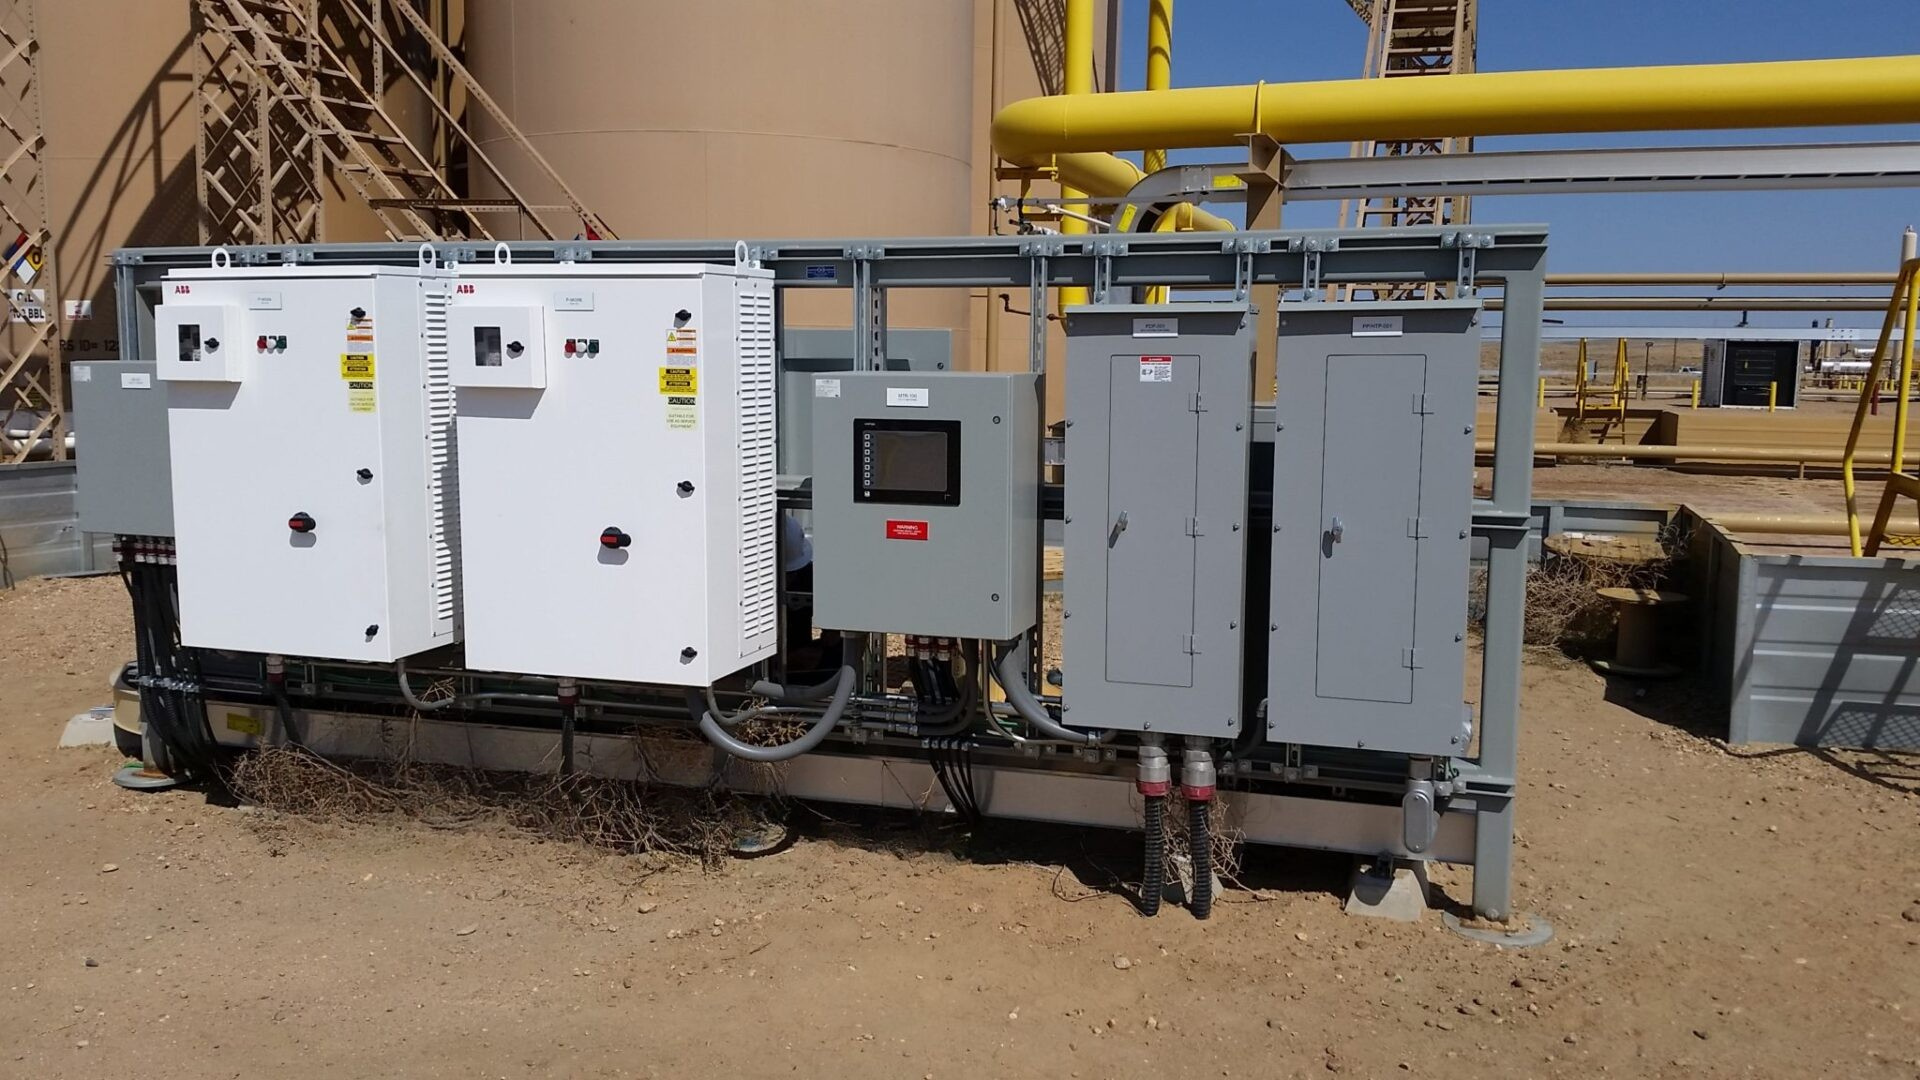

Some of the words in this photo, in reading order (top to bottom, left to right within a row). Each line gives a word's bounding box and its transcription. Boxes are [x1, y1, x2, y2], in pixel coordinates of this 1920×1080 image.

[175, 285, 190, 294] ABB
[457, 285, 475, 294] ABB
[28, 308, 45, 319] BBL
